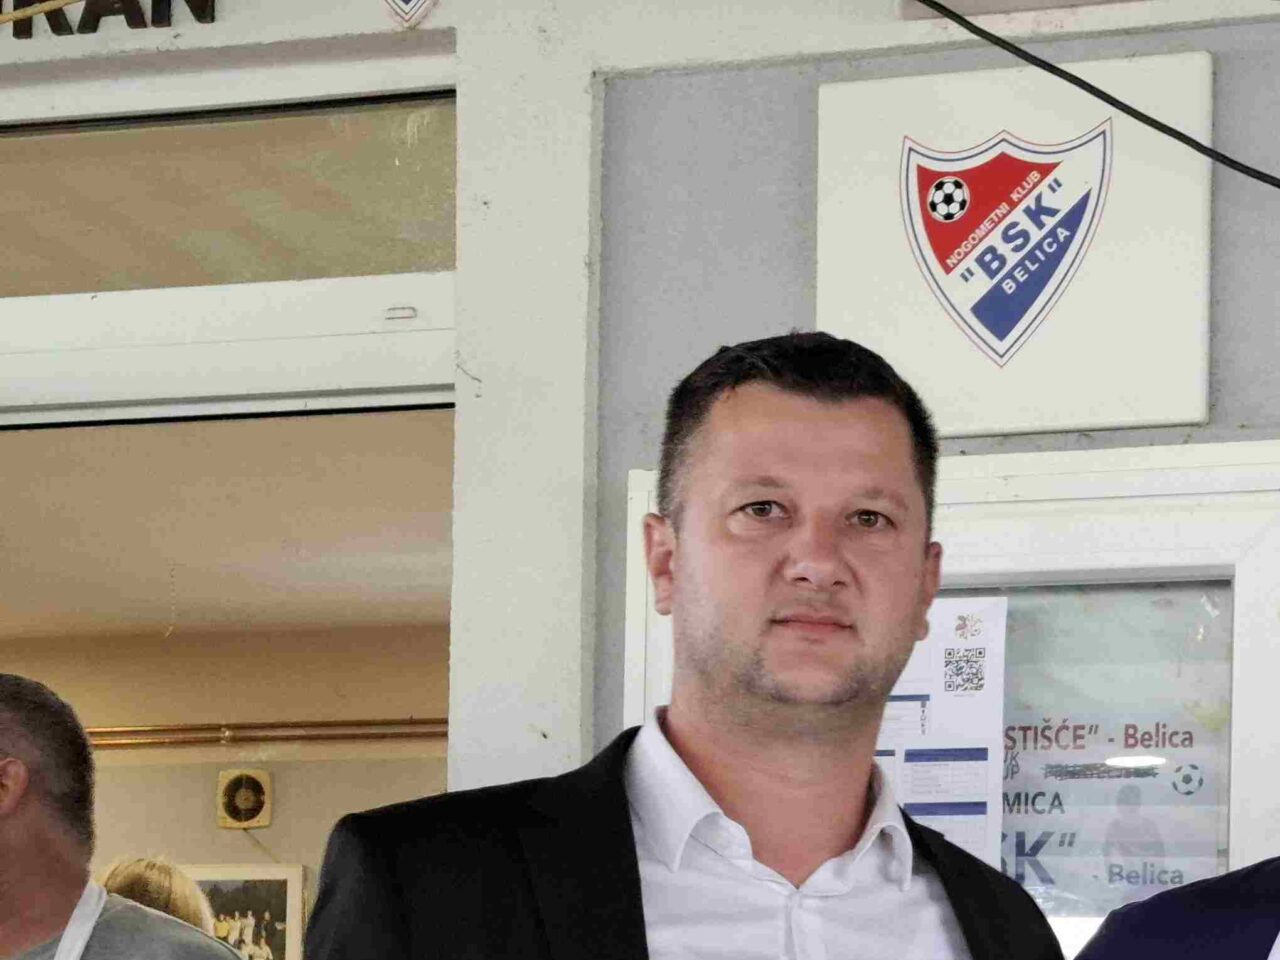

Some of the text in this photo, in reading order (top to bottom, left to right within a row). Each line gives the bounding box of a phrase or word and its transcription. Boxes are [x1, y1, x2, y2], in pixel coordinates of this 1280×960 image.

[946, 170, 1042, 268] NOGOMETNI KLUB
[960, 177, 1063, 283] "BSK"
[1001, 226, 1071, 295] BELICA
[1123, 722, 1194, 749] Belica
[1108, 862, 1184, 885] Belica
